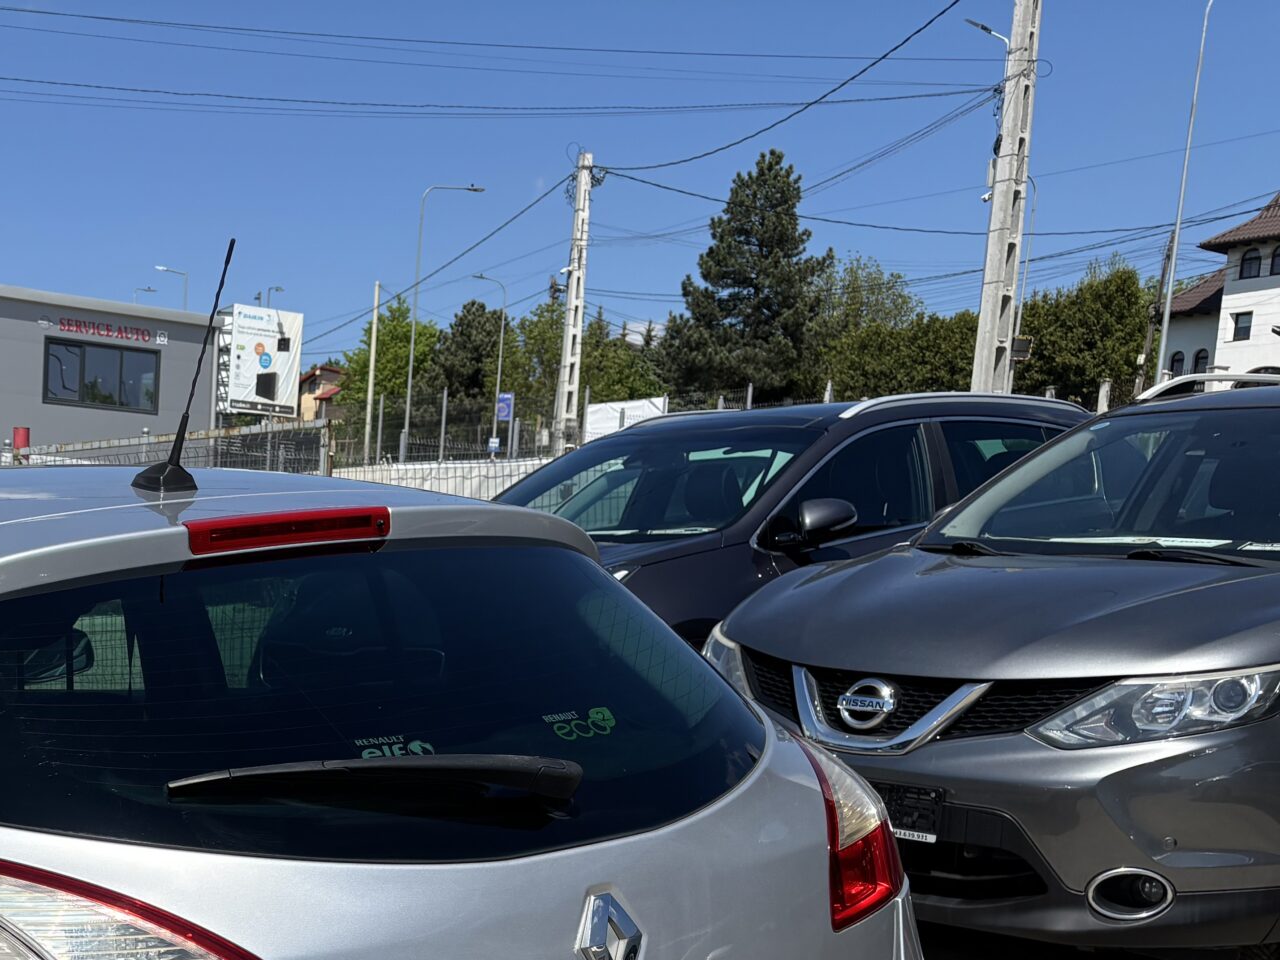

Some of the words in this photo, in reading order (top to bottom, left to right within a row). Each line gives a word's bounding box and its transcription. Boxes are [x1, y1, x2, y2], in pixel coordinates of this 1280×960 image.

[58, 318, 113, 338] SERVICE
[115, 326, 151, 342] AUTO
[841, 697, 885, 709] NISSAN
[541, 710, 580, 724] RENAULT
[354, 735, 405, 747] RENAULT
